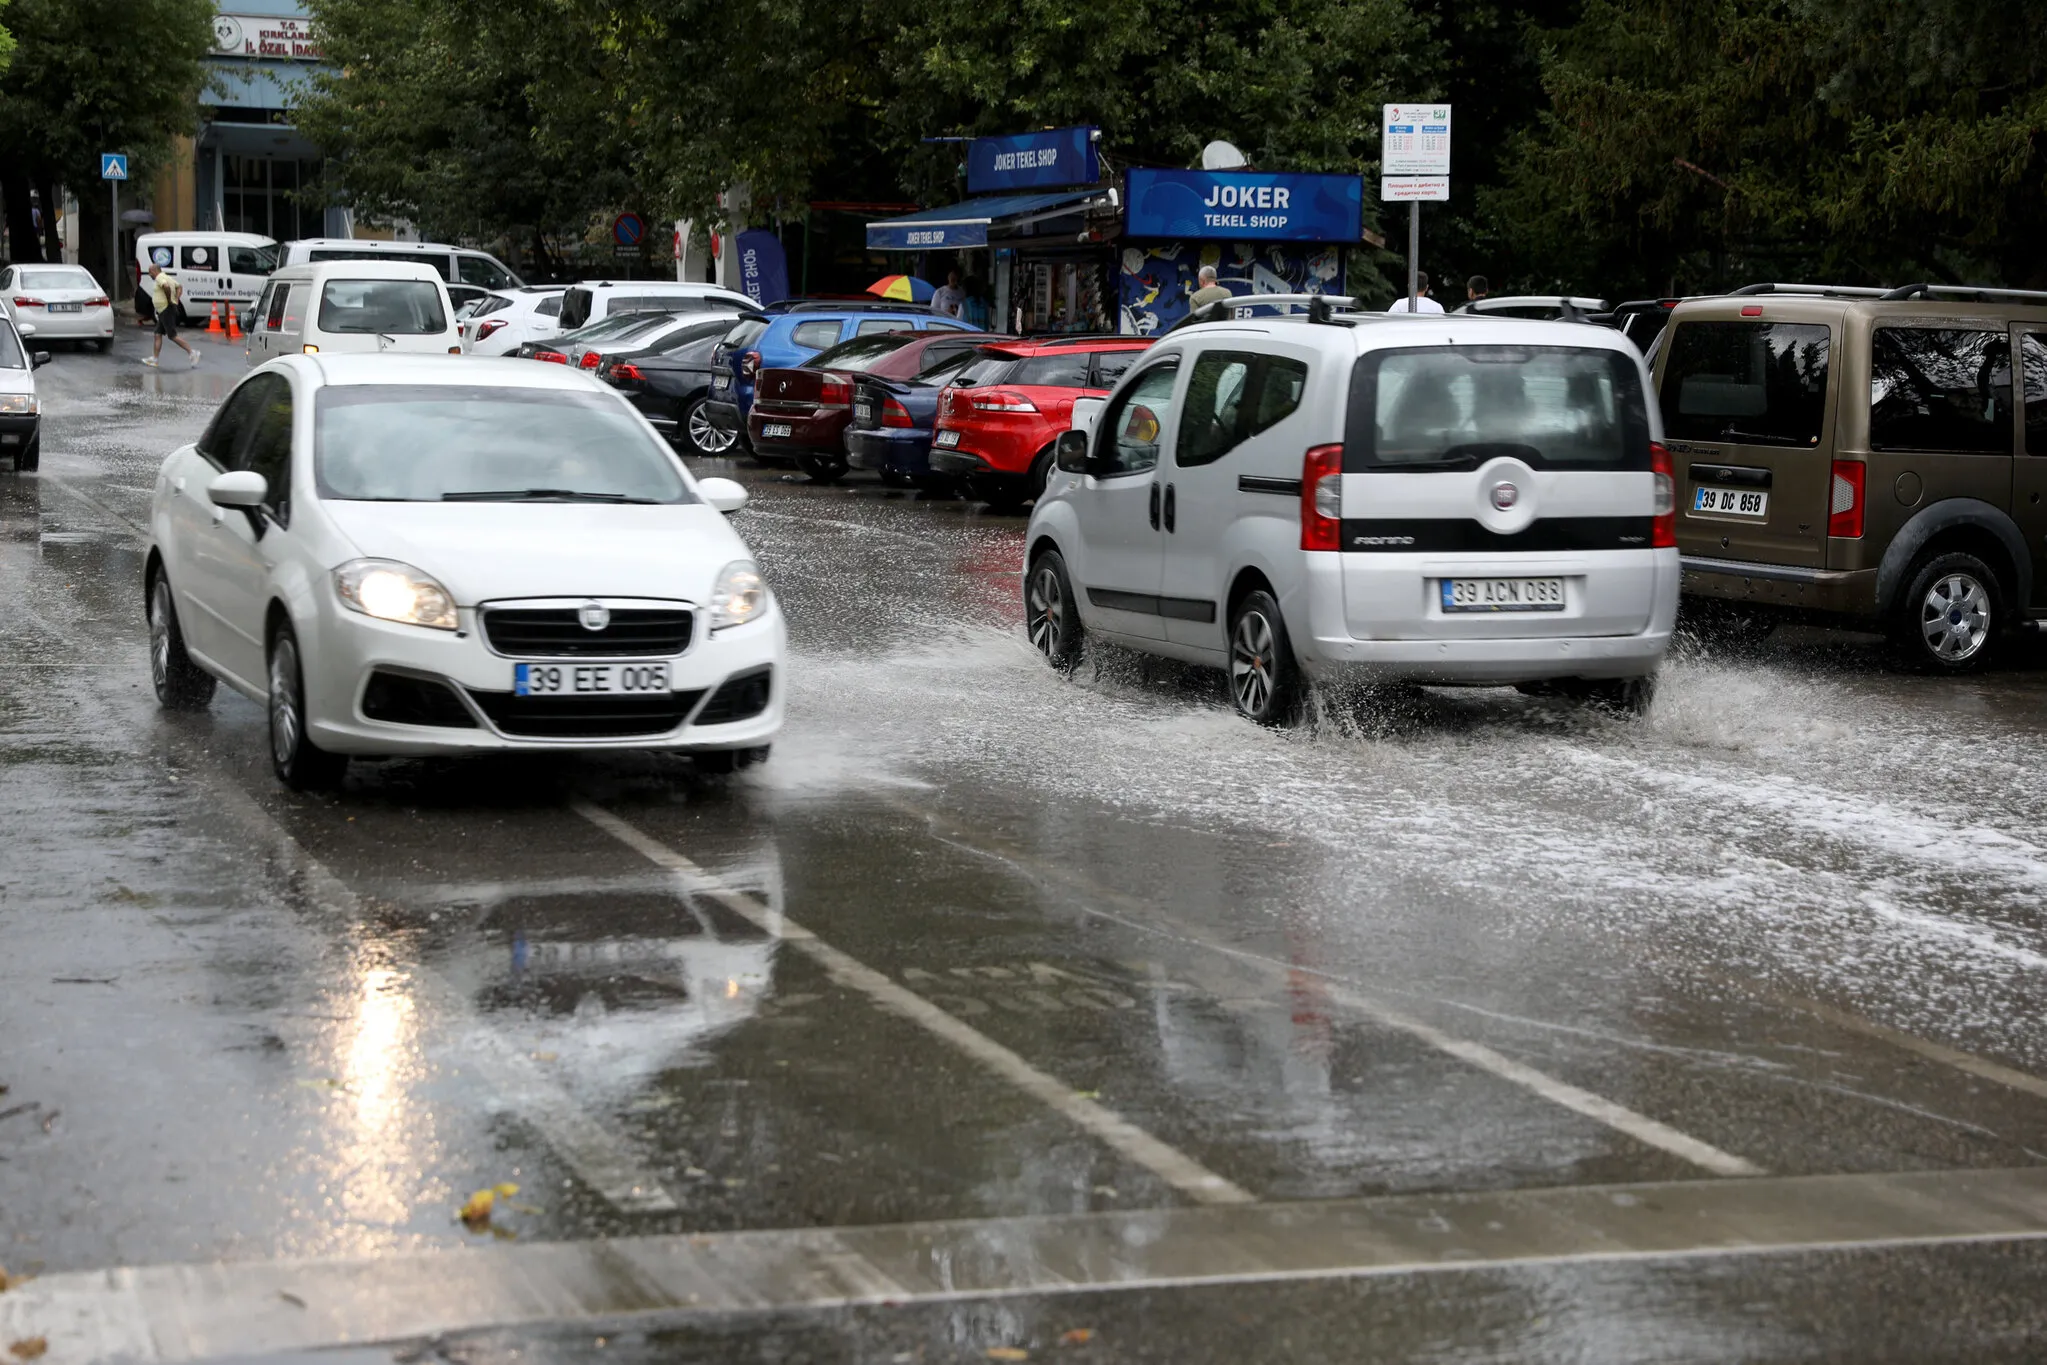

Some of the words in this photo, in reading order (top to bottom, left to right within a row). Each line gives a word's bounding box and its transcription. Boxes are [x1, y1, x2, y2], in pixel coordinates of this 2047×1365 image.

[259, 39, 288, 56] ÖZEL
[994, 153, 1016, 171] JOKER
[1016, 150, 1037, 169] TEKEL
[1038, 148, 1057, 167] SHOP
[1204, 185, 1290, 209] JOKER
[1204, 214, 1247, 227] TEKEL
[1250, 215, 1288, 228] SHOP
[1702, 491, 1717, 508] 39
[1720, 492, 1735, 510] DC
[1740, 493, 1762, 512] 858
[1454, 582, 1477, 602] 39
[1486, 581, 1519, 602] ACN
[530, 667, 561, 692] 39
[574, 666, 611, 692] EE
[622, 666, 667, 691] 005
